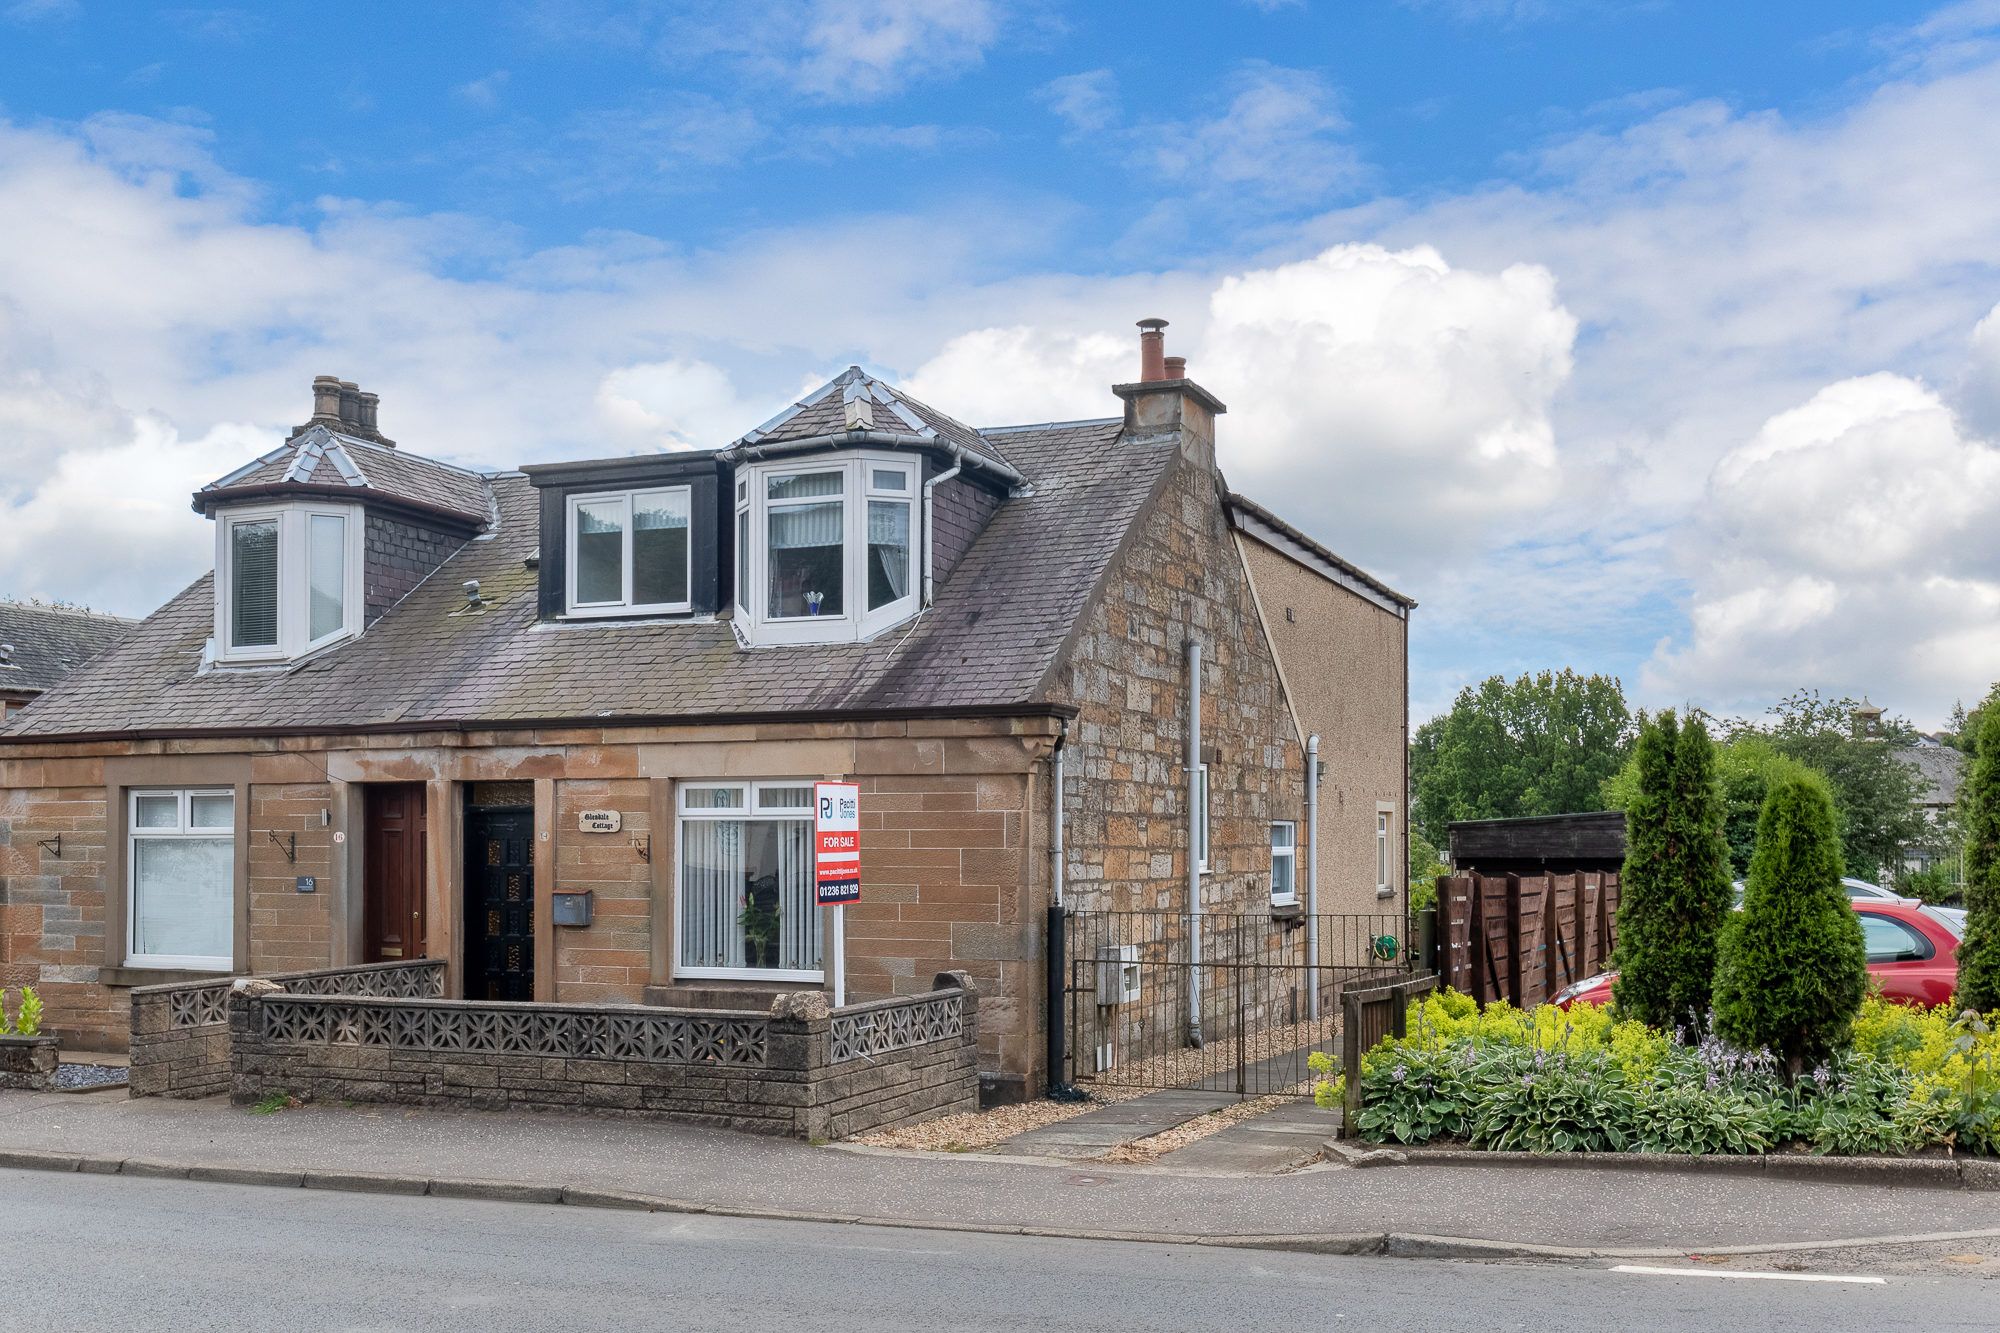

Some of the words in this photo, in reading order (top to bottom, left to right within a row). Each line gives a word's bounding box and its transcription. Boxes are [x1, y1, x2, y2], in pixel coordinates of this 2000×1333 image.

[839, 809, 856, 819] Jones
[823, 837, 839, 848] FOR
[840, 836, 855, 847] SALE
[305, 878, 313, 886] 16
[820, 886, 840, 897] 01236
[840, 885, 849, 895] 821
[850, 884, 859, 894] 929
